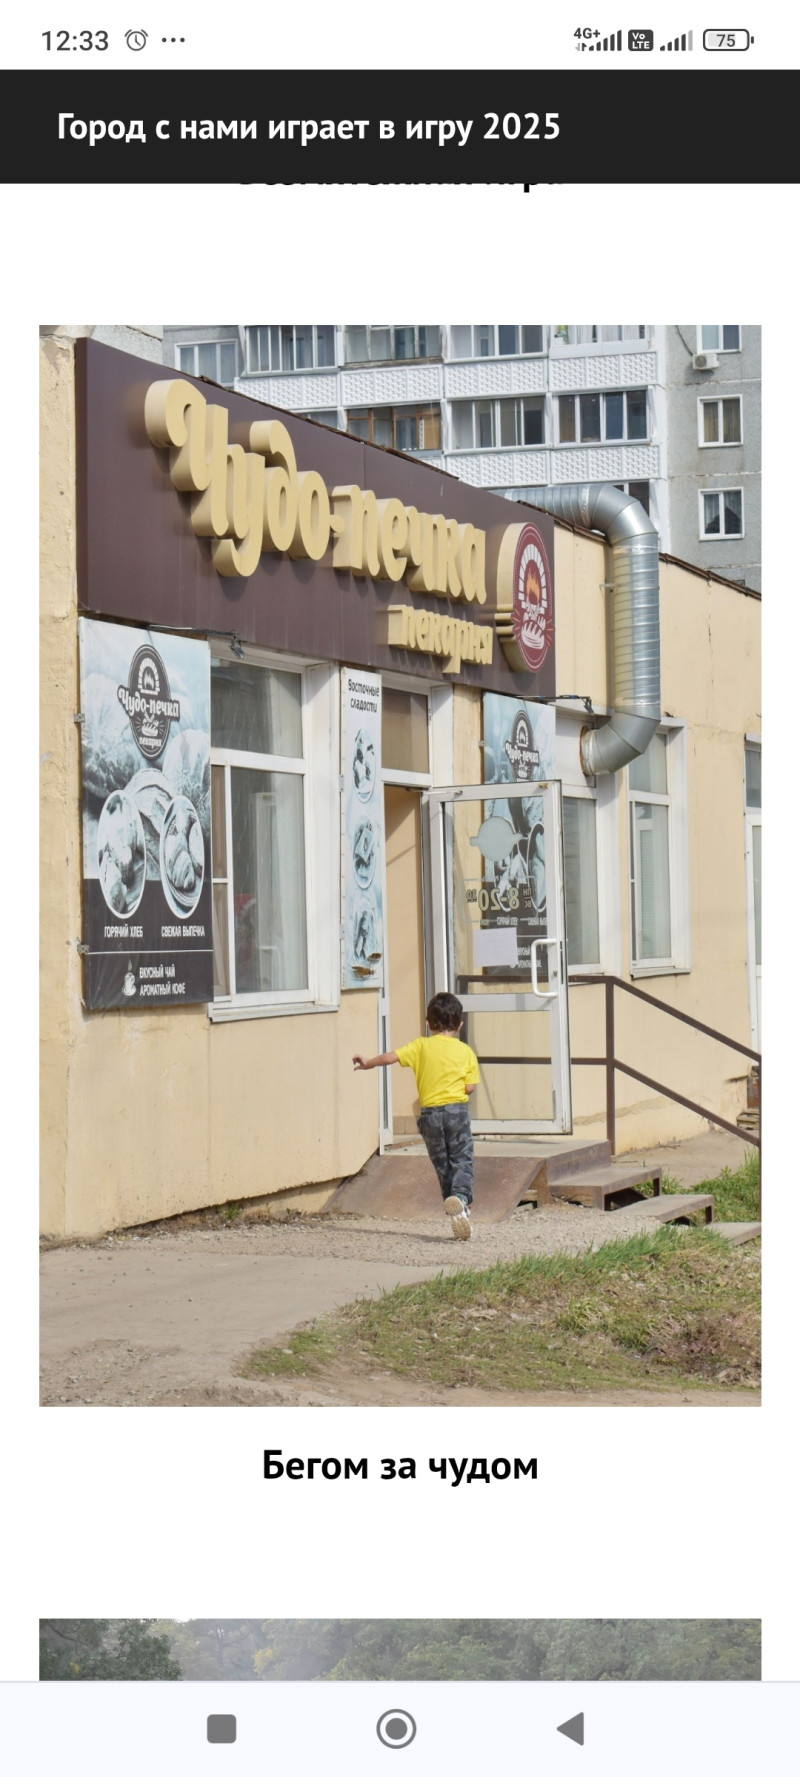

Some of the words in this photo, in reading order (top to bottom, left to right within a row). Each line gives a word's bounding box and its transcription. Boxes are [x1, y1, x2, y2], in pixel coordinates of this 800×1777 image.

[144, 378, 487, 605] Чудо-печка
[387, 604, 493, 674] пекарня
[348, 678, 380, 697] Восточные
[117, 687, 180, 718] Чудо-печка
[350, 698, 378, 713] сладости
[104, 924, 128, 937] ГОРЯЧИЙ
[130, 926, 143, 937] ХЛЕБ
[161, 926, 181, 937] СВЕЖАЯ
[182, 925, 205, 937] ВЫПЕЧКА
[139, 964, 163, 978] ВКУСНЫЙ
[165, 963, 175, 977] ЧАЙ
[140, 981, 171, 996] АРОМАТНЫЙ
[172, 982, 185, 994] КОФЕ
